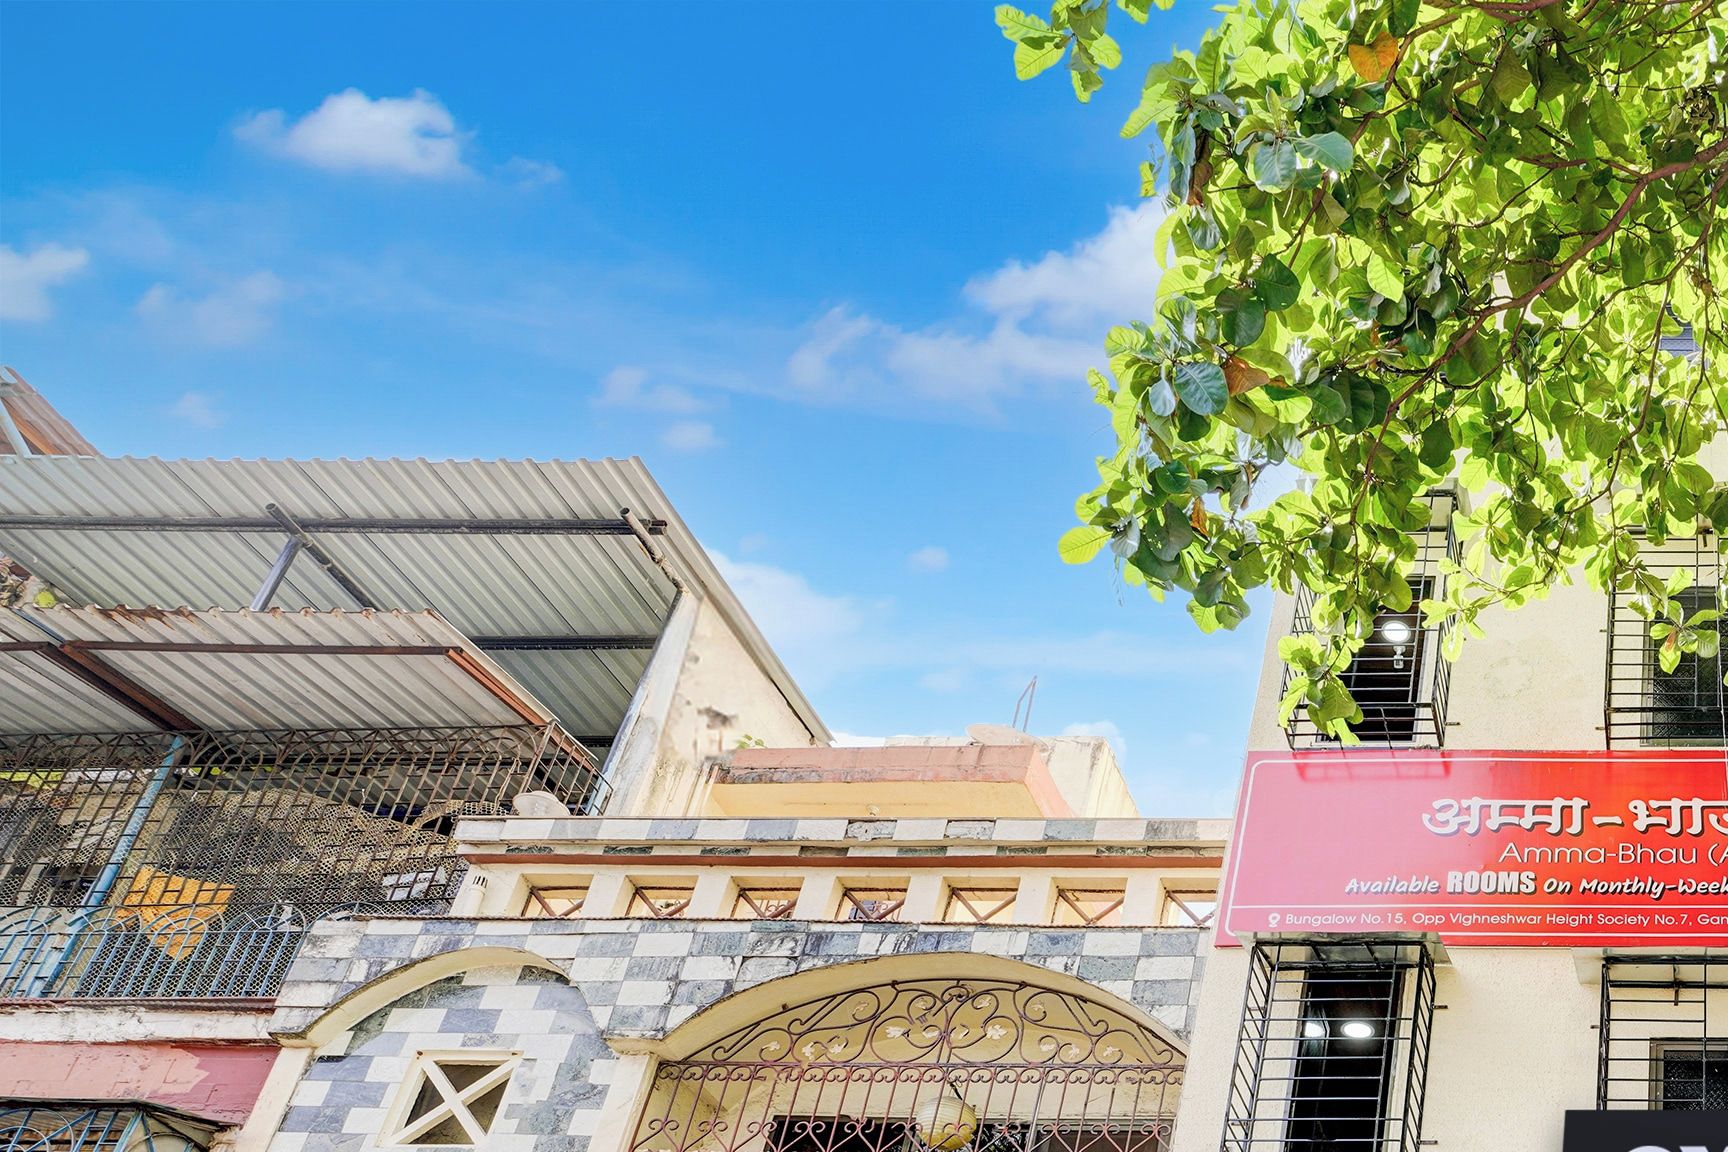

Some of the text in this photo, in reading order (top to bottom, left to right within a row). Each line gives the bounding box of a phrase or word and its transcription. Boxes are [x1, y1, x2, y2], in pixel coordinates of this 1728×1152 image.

[1499, 842, 1697, 865] Amma-Bhau
[1344, 875, 1440, 893] Available
[1446, 871, 1537, 895] ROOMS
[1543, 878, 1571, 894] On
[1286, 912, 1356, 927] Bungalow
[1412, 912, 1445, 927] Opp
[1449, 912, 1542, 927] Vighneshwar
[1546, 912, 1594, 927] Height
[1597, 913, 1650, 927] Society
[1654, 913, 1693, 927] No.7,
